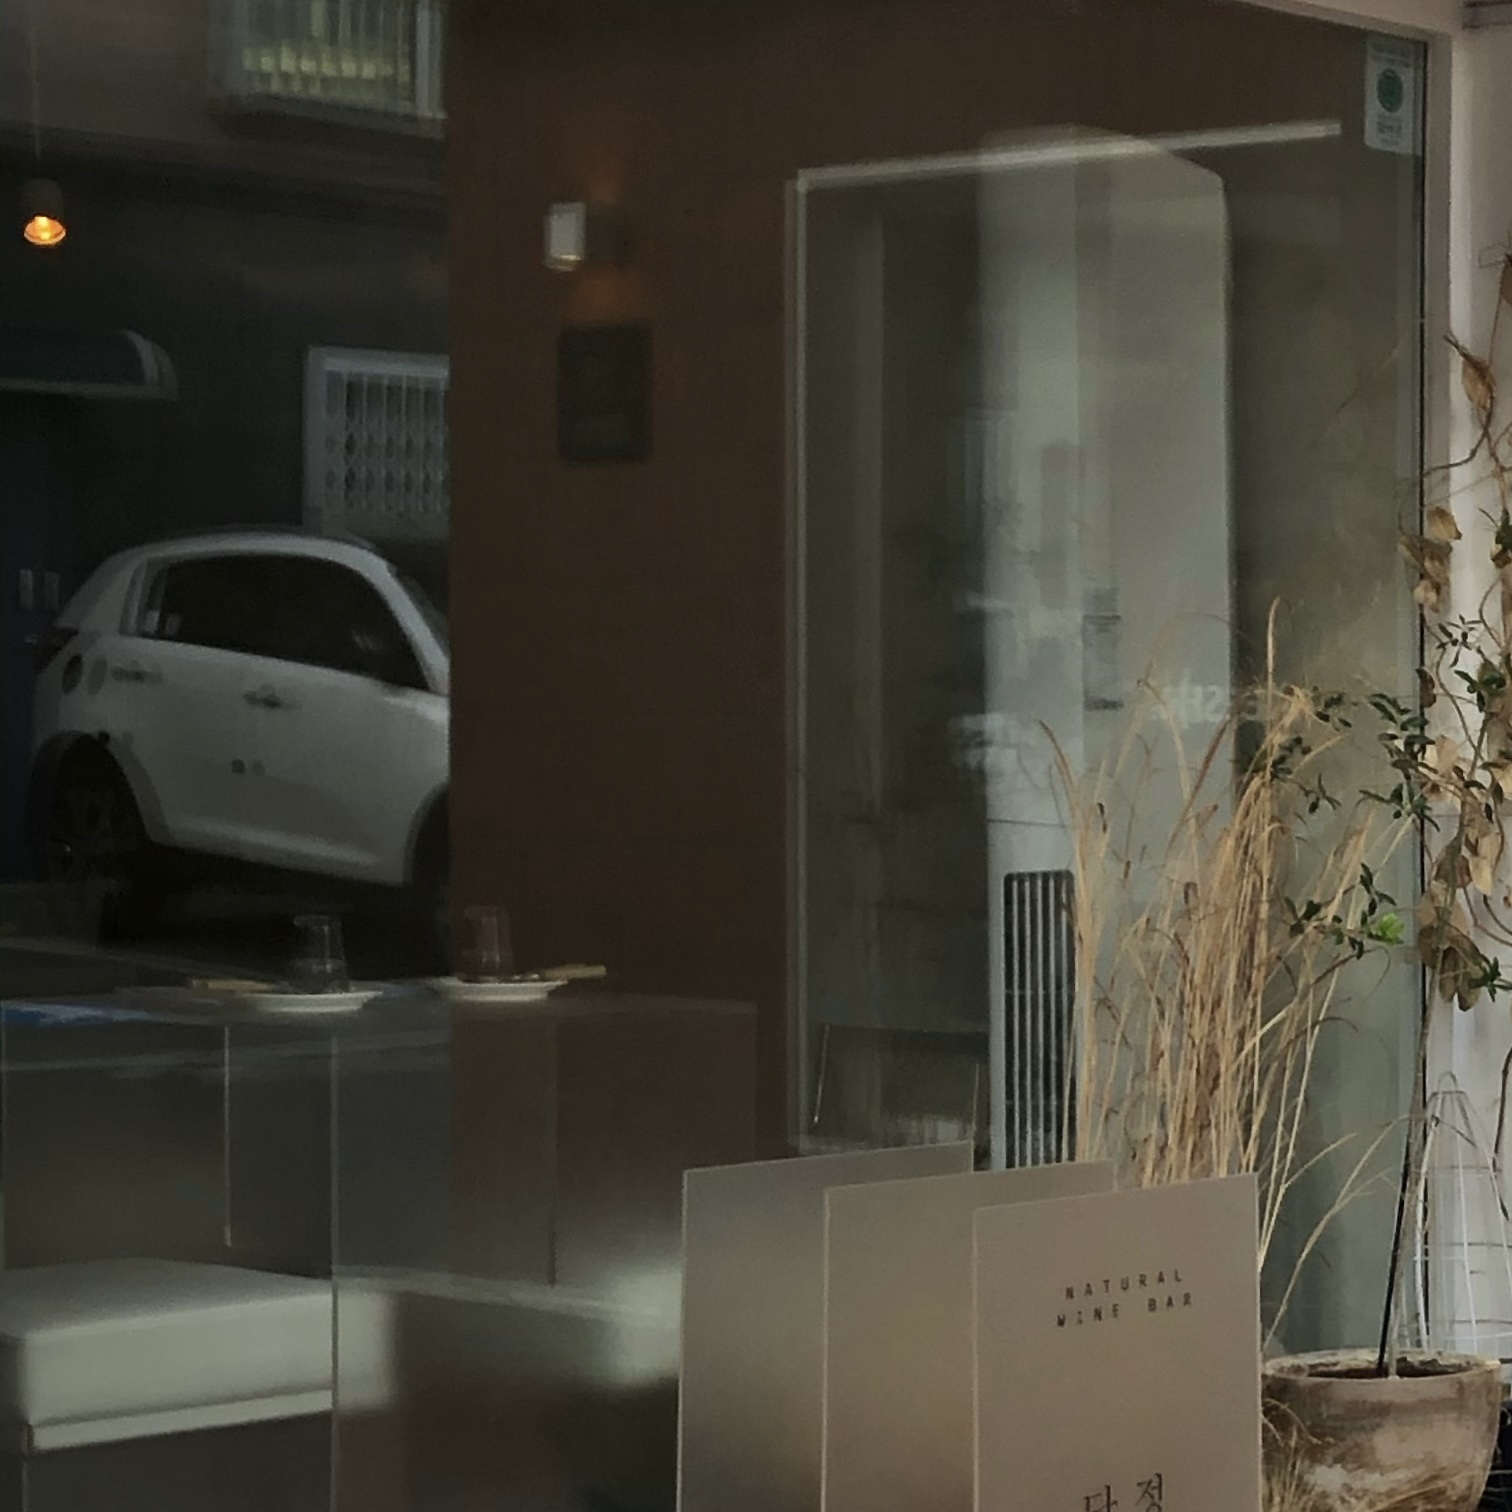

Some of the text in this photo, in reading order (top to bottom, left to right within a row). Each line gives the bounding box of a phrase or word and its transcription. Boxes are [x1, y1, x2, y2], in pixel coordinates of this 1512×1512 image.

[1065, 1269, 1183, 1301] NATURAL
[1057, 1292, 1192, 1329] WINE BAR
